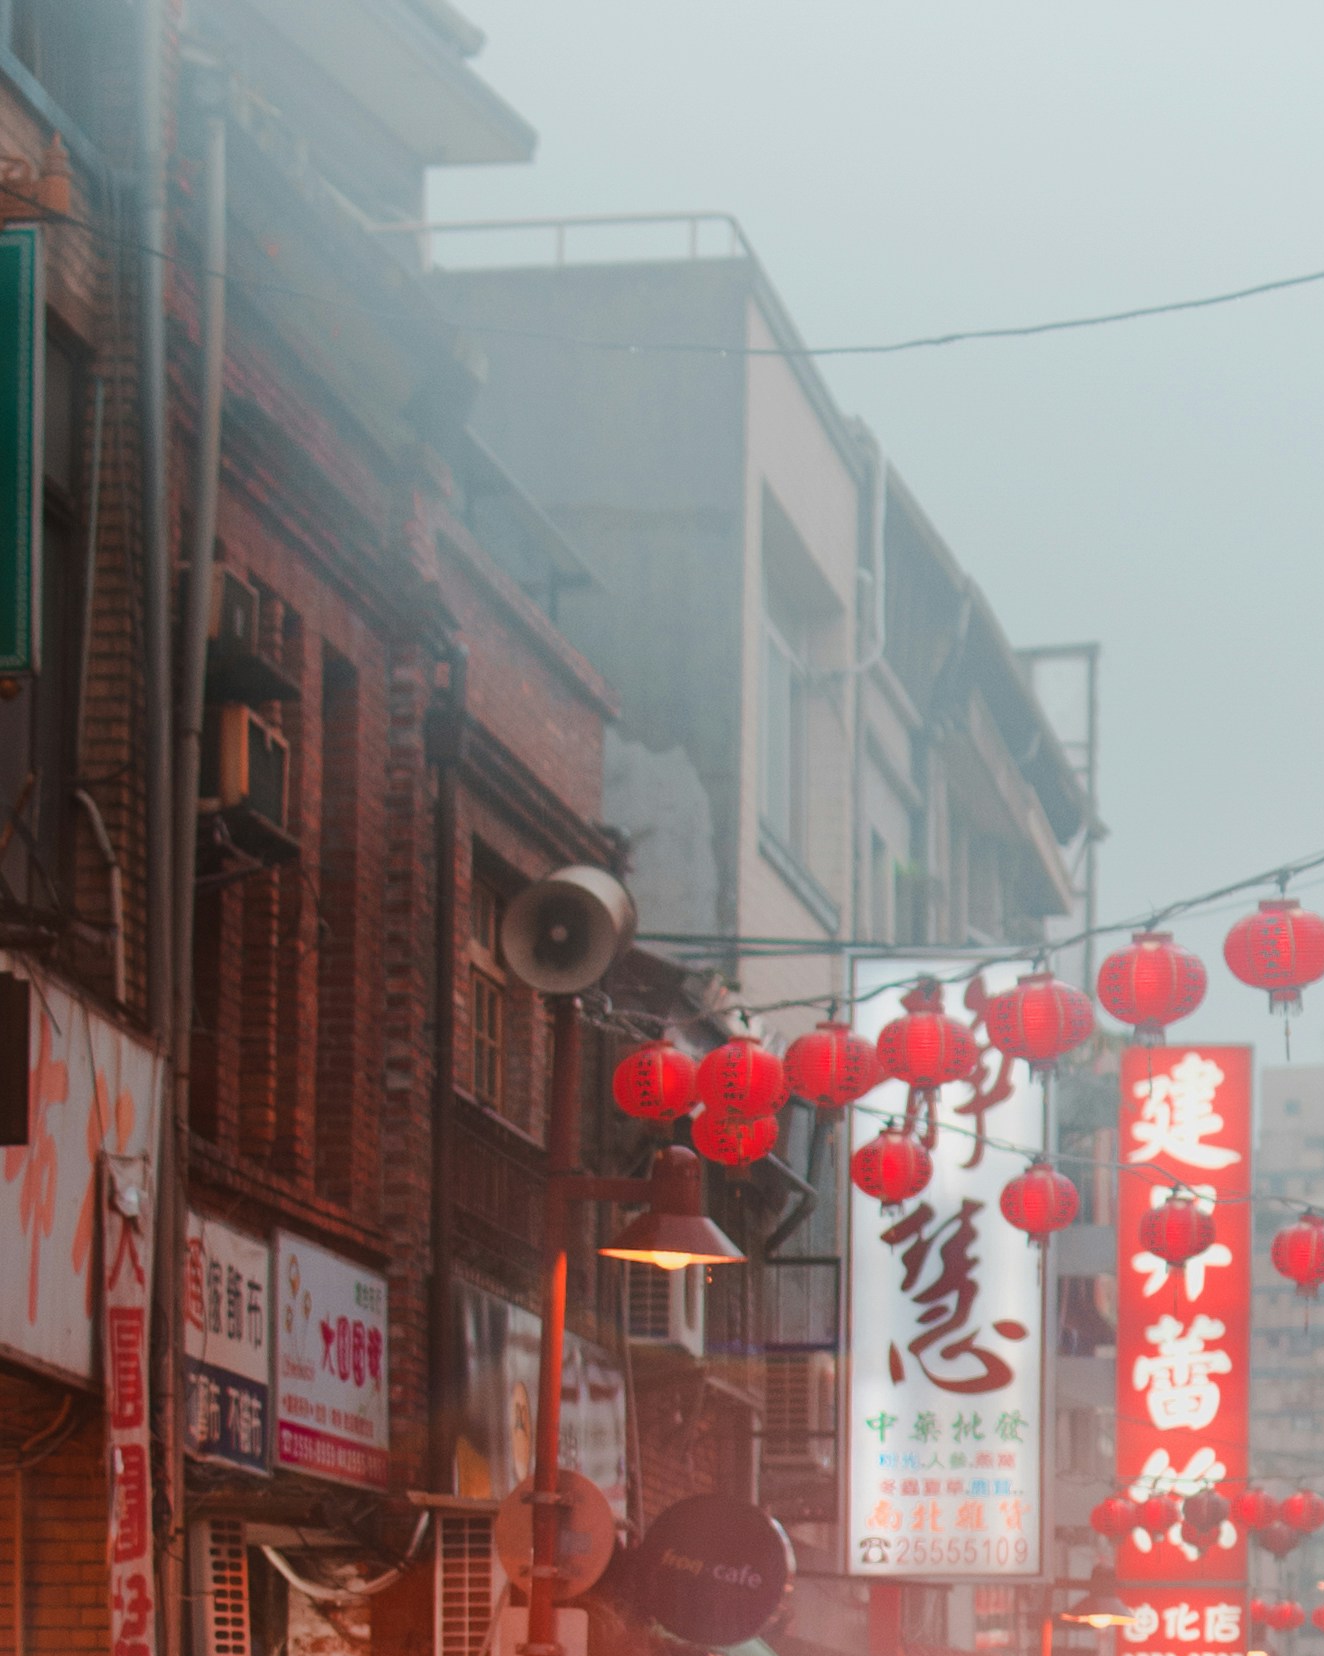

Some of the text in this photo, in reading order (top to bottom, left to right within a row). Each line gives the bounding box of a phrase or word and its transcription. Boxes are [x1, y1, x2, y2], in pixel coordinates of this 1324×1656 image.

[866, 1410, 1029, 1443] 中藥批發
[896, 1537, 1030, 1565] 25555109
[1123, 1602, 1242, 1643] 迪化店
